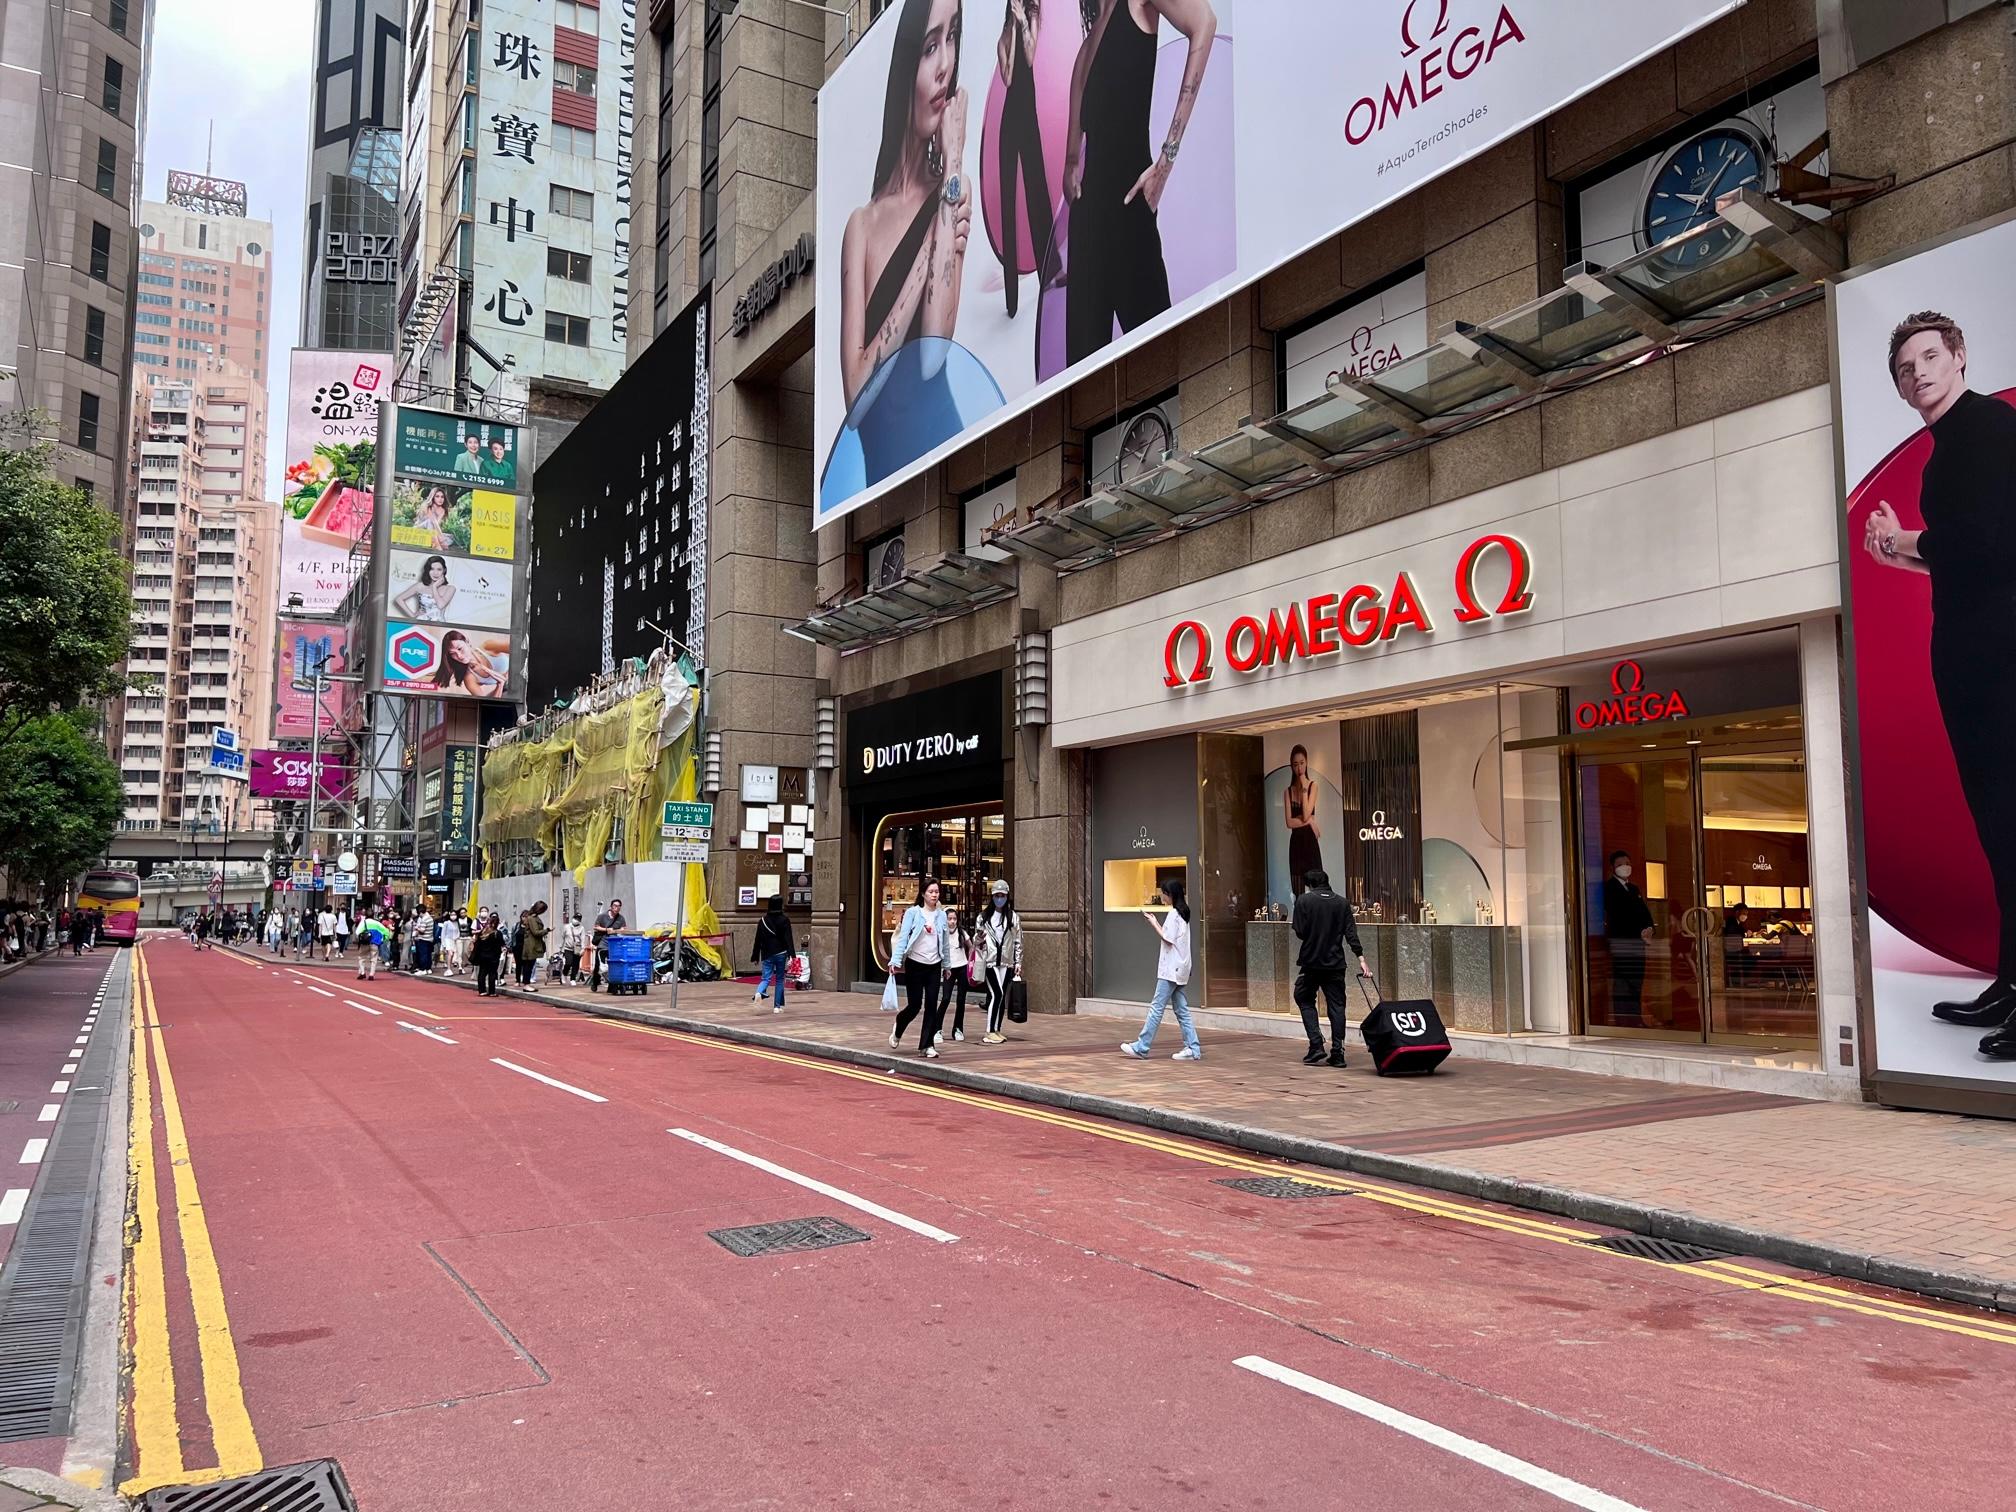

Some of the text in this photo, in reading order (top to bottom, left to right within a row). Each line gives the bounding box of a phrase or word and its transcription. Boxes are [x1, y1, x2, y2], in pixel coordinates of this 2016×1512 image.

[1344, 4, 1526, 145] OMEGA
[1376, 104, 1489, 177] #AquaTerraShades
[484, 31, 542, 326] 珠寶中心
[468, 475, 505, 487] 2152 6999
[315, 579, 342, 590] Now
[1225, 571, 1434, 673] OMEGA
[401, 647, 428, 659] PURE
[1575, 689, 1690, 730] OMEGA
[877, 740, 912, 768] DUTY
[916, 732, 954, 761] ZERO
[956, 738, 965, 755] by
[286, 776, 308, 787] 莎莎
[672, 812, 704, 823] 的士站
[675, 828, 686, 837] 12
[702, 830, 709, 838] 6
[1359, 826, 1403, 841] OMEGA
[1131, 837, 1156, 849] OMEGA
[383, 859, 414, 867] MASSAGE
[1752, 862, 1773, 871] OMEGA
